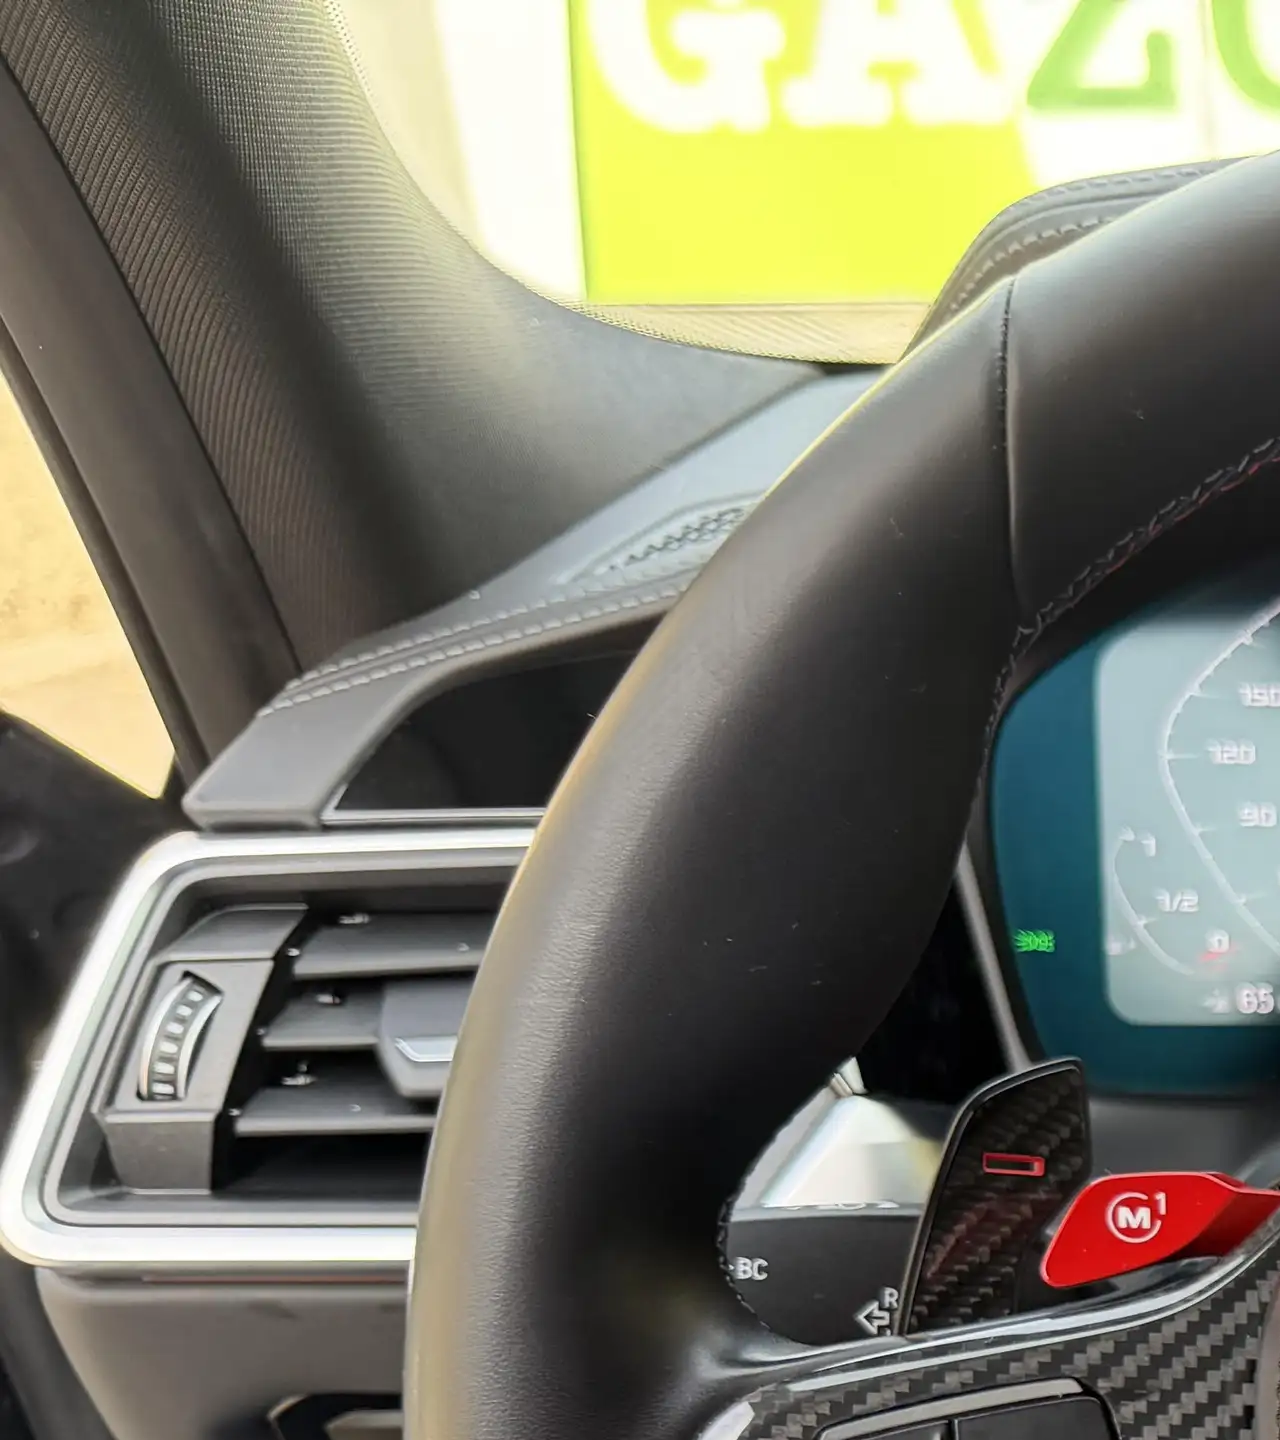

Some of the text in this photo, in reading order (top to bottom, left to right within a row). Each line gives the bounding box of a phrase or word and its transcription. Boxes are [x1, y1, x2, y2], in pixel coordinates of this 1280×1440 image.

[1207, 739, 1256, 764] 120
[1238, 803, 1277, 828] 90
[1155, 889, 1199, 912] 1/2
[735, 1257, 769, 1281] BC
